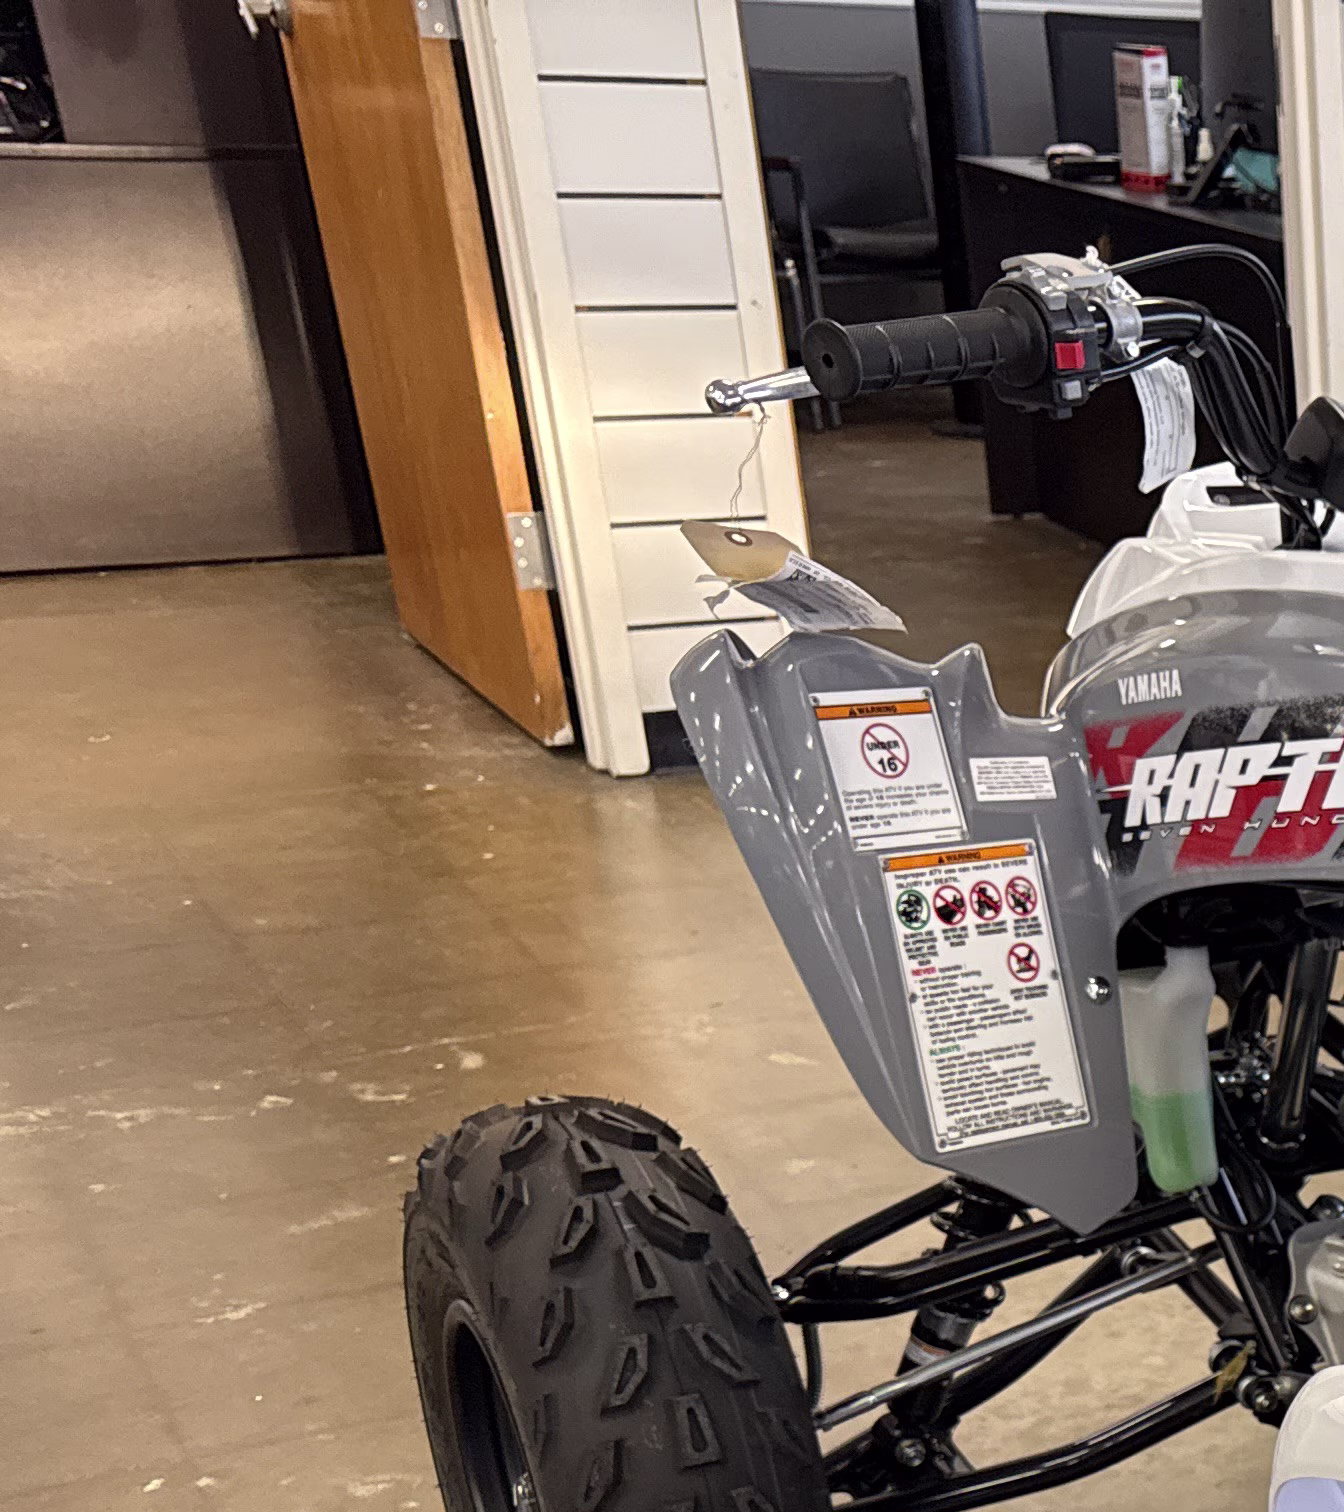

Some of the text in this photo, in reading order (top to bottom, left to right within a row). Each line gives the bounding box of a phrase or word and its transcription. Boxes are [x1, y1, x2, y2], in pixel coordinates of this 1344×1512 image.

[1117, 669, 1183, 705] YAMAHA
[858, 705, 897, 715] WARNING
[866, 740, 900, 751] UNDER
[878, 757, 898, 773] 16
[1121, 822, 1216, 842] SEVEN
[946, 851, 981, 863] WARNING
